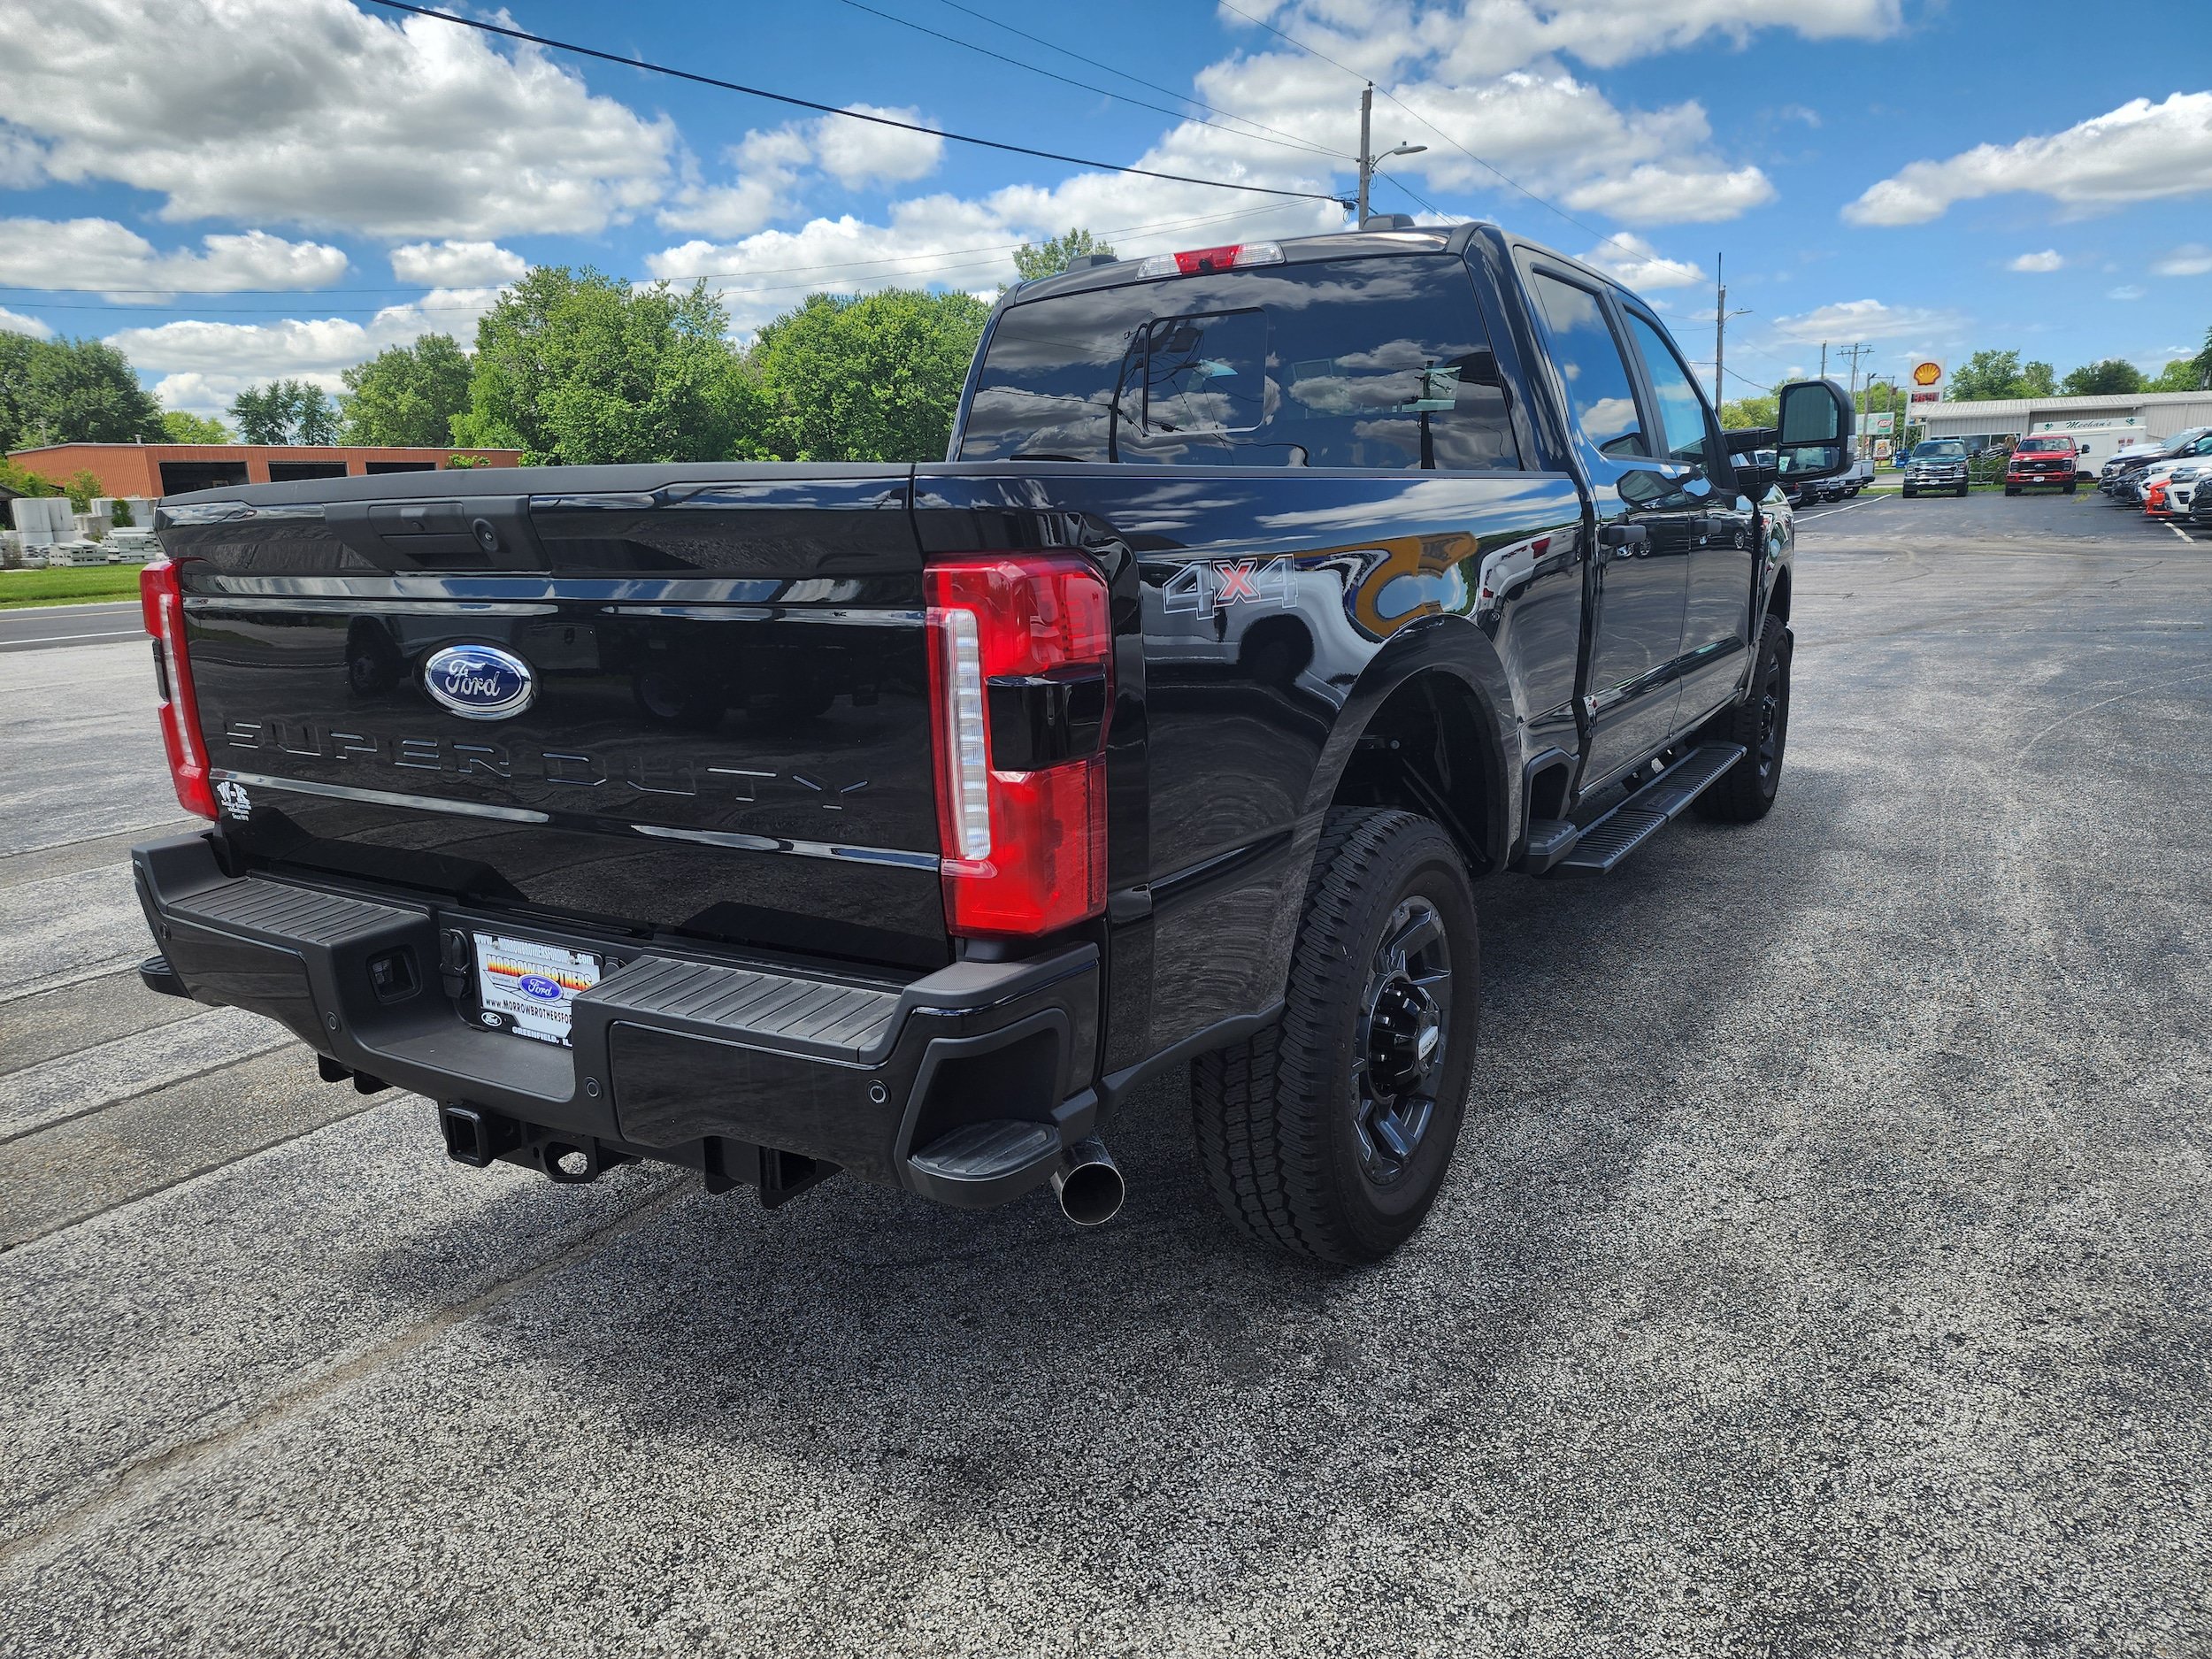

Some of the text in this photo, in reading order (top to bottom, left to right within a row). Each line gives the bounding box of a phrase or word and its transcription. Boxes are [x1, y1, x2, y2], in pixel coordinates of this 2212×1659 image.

[445, 660, 501, 697] Ford
[224, 719, 869, 810] SUPER DUTY
[527, 978, 553, 997] Ford
[485, 997, 572, 1025] www.MORROWBROTHERSFOR
[511, 1025, 559, 1044] GREENFIELD,
